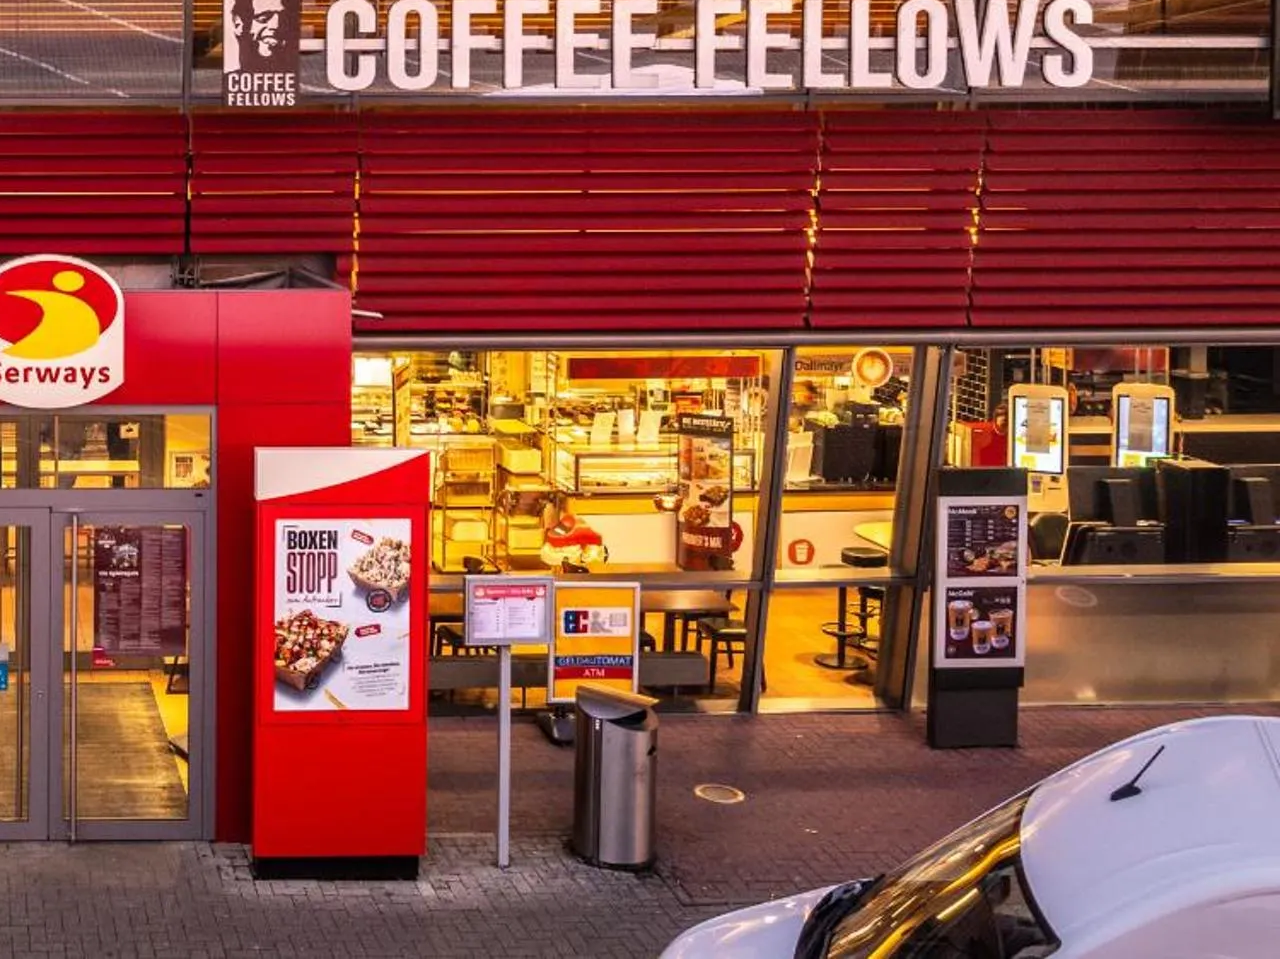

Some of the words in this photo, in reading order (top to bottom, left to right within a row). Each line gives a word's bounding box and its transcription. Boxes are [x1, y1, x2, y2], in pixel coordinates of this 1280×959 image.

[227, 72, 296, 92] COFFEE
[227, 92, 296, 107] FELLOWS
[286, 530, 338, 550] BOXEN
[286, 552, 338, 594] STOPP
[582, 668, 606, 678] ATM
